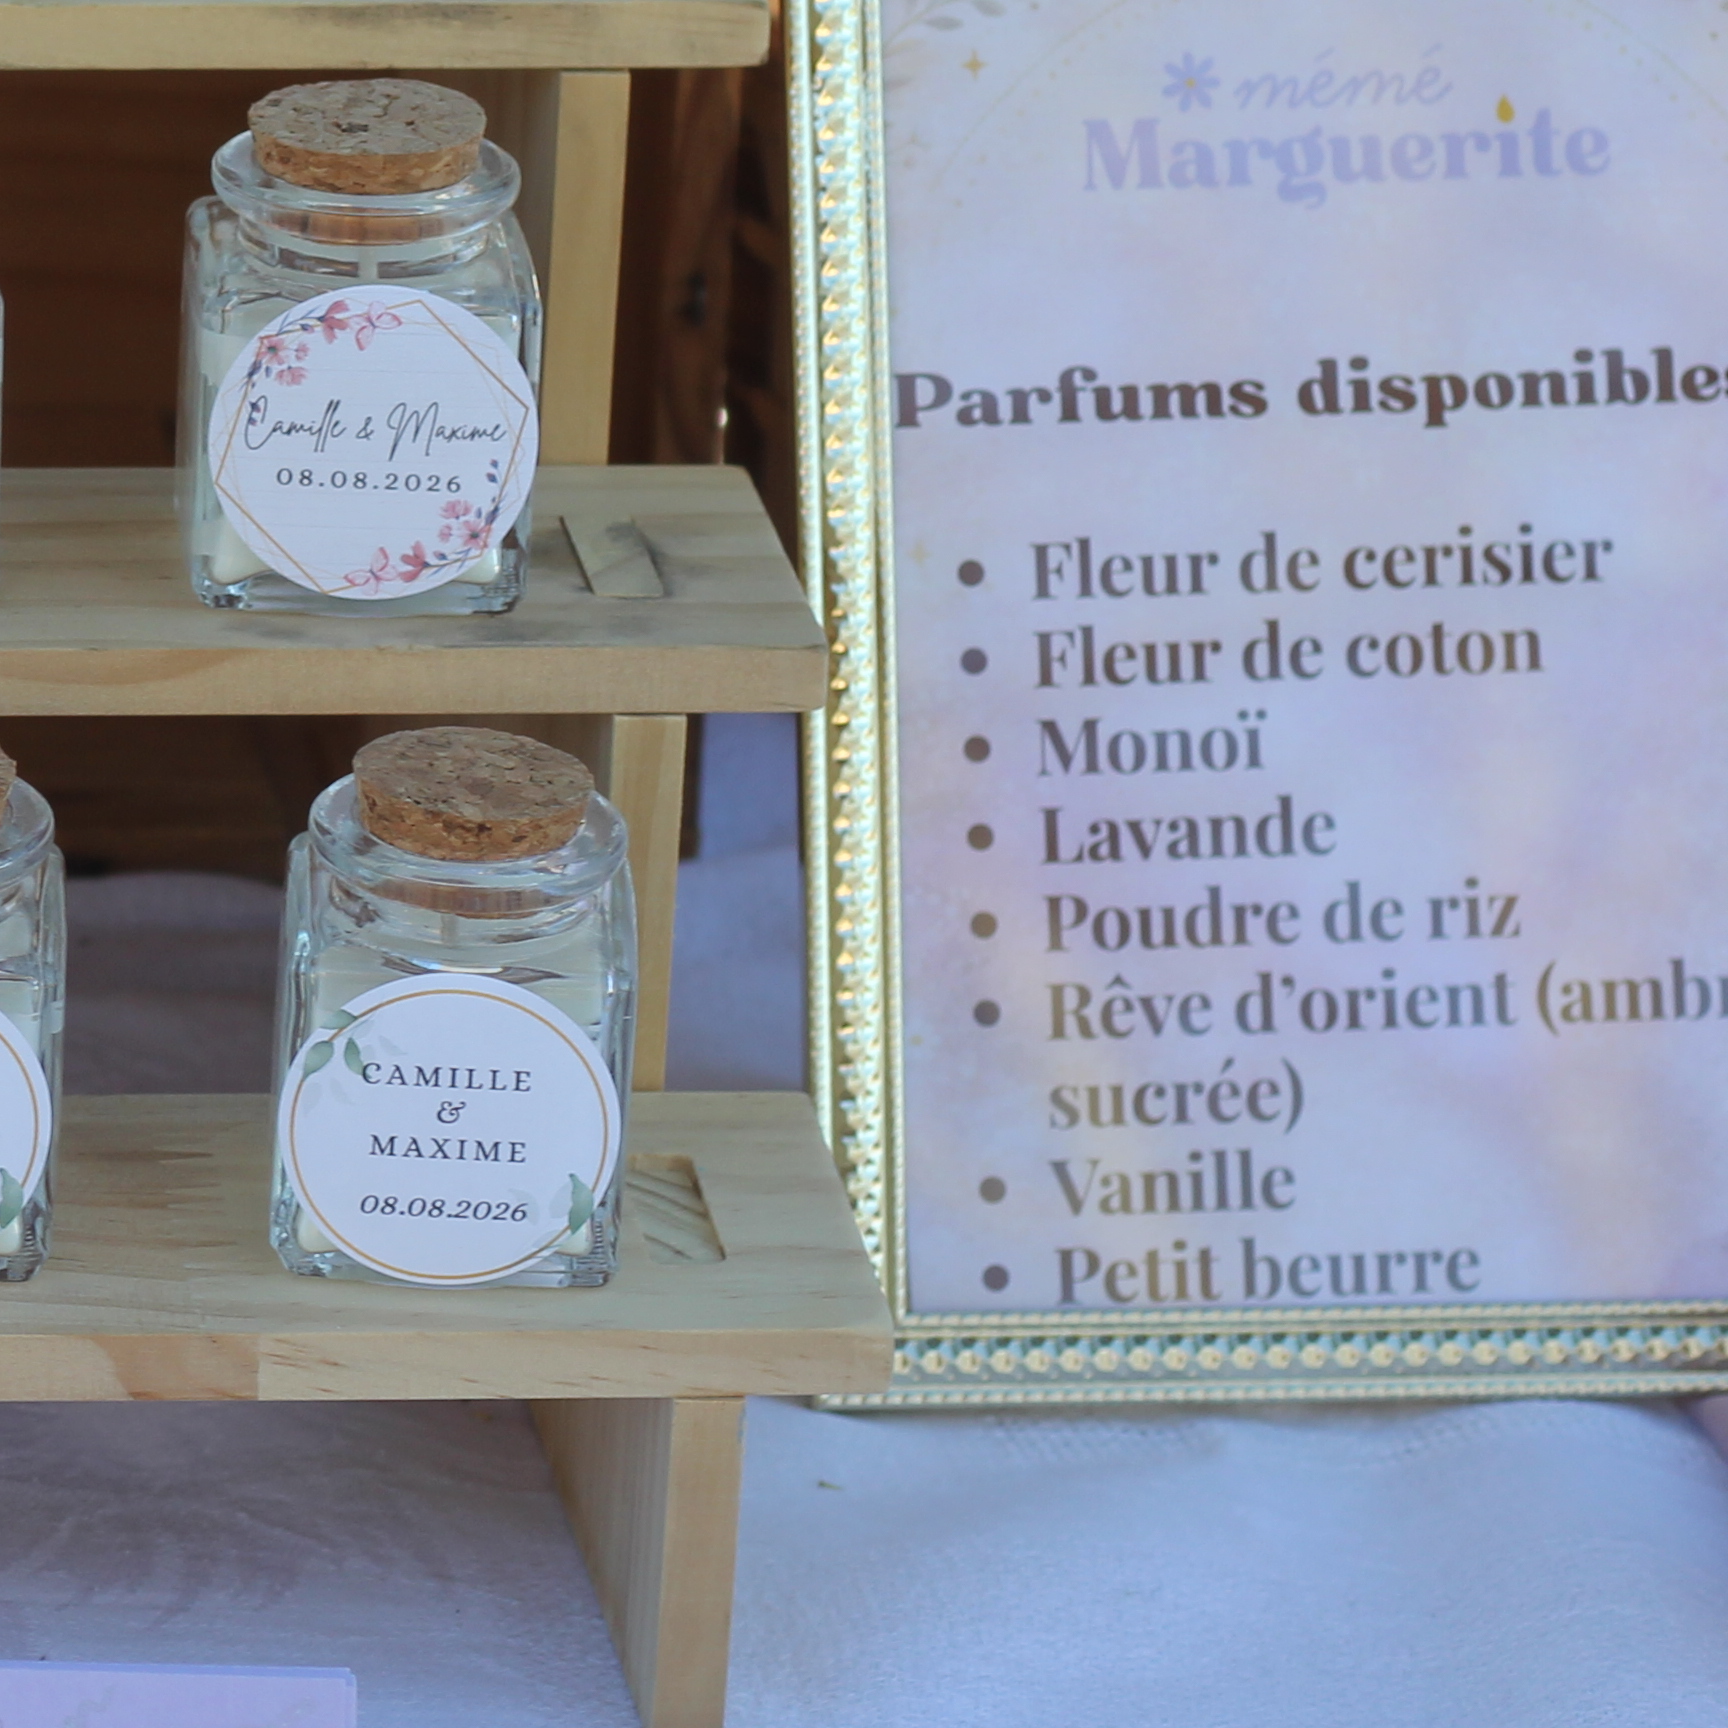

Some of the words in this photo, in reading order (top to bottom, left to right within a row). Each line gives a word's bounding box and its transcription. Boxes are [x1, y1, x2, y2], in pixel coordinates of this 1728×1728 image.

[1233, 42, 1453, 103] mémé
[1083, 91, 1611, 204] Marguerite
[894, 358, 1269, 427] Parfums
[1295, 344, 1728, 424] disponible
[245, 395, 348, 452] Camille
[356, 418, 375, 441] &
[386, 401, 508, 462] Maxime
[276, 467, 463, 494] 08.08.2026
[1031, 529, 1218, 601] Fleur
[1238, 525, 1323, 591] de
[1343, 522, 1613, 587] cerisier
[1034, 617, 1221, 687] Fleur
[1241, 614, 1326, 679] de
[1346, 615, 1545, 676] coton
[1035, 707, 1266, 775] Monoï
[1039, 796, 1336, 864] Lavande
[1042, 885, 1302, 953] Poudre
[1322, 877, 1404, 942] de
[1424, 880, 1522, 938] riz
[1046, 971, 1214, 1039] Rêve
[361, 1062, 532, 1093] CAMILLE
[1047, 1055, 1306, 1135] sucrée)
[436, 1100, 466, 1124] &
[369, 1134, 527, 1164] MAXIME
[1049, 1151, 1297, 1214] Vanille
[359, 1195, 529, 1222] 08.08.2026
[1055, 1237, 1221, 1302] Petit
[1238, 1234, 1481, 1298] beurre
